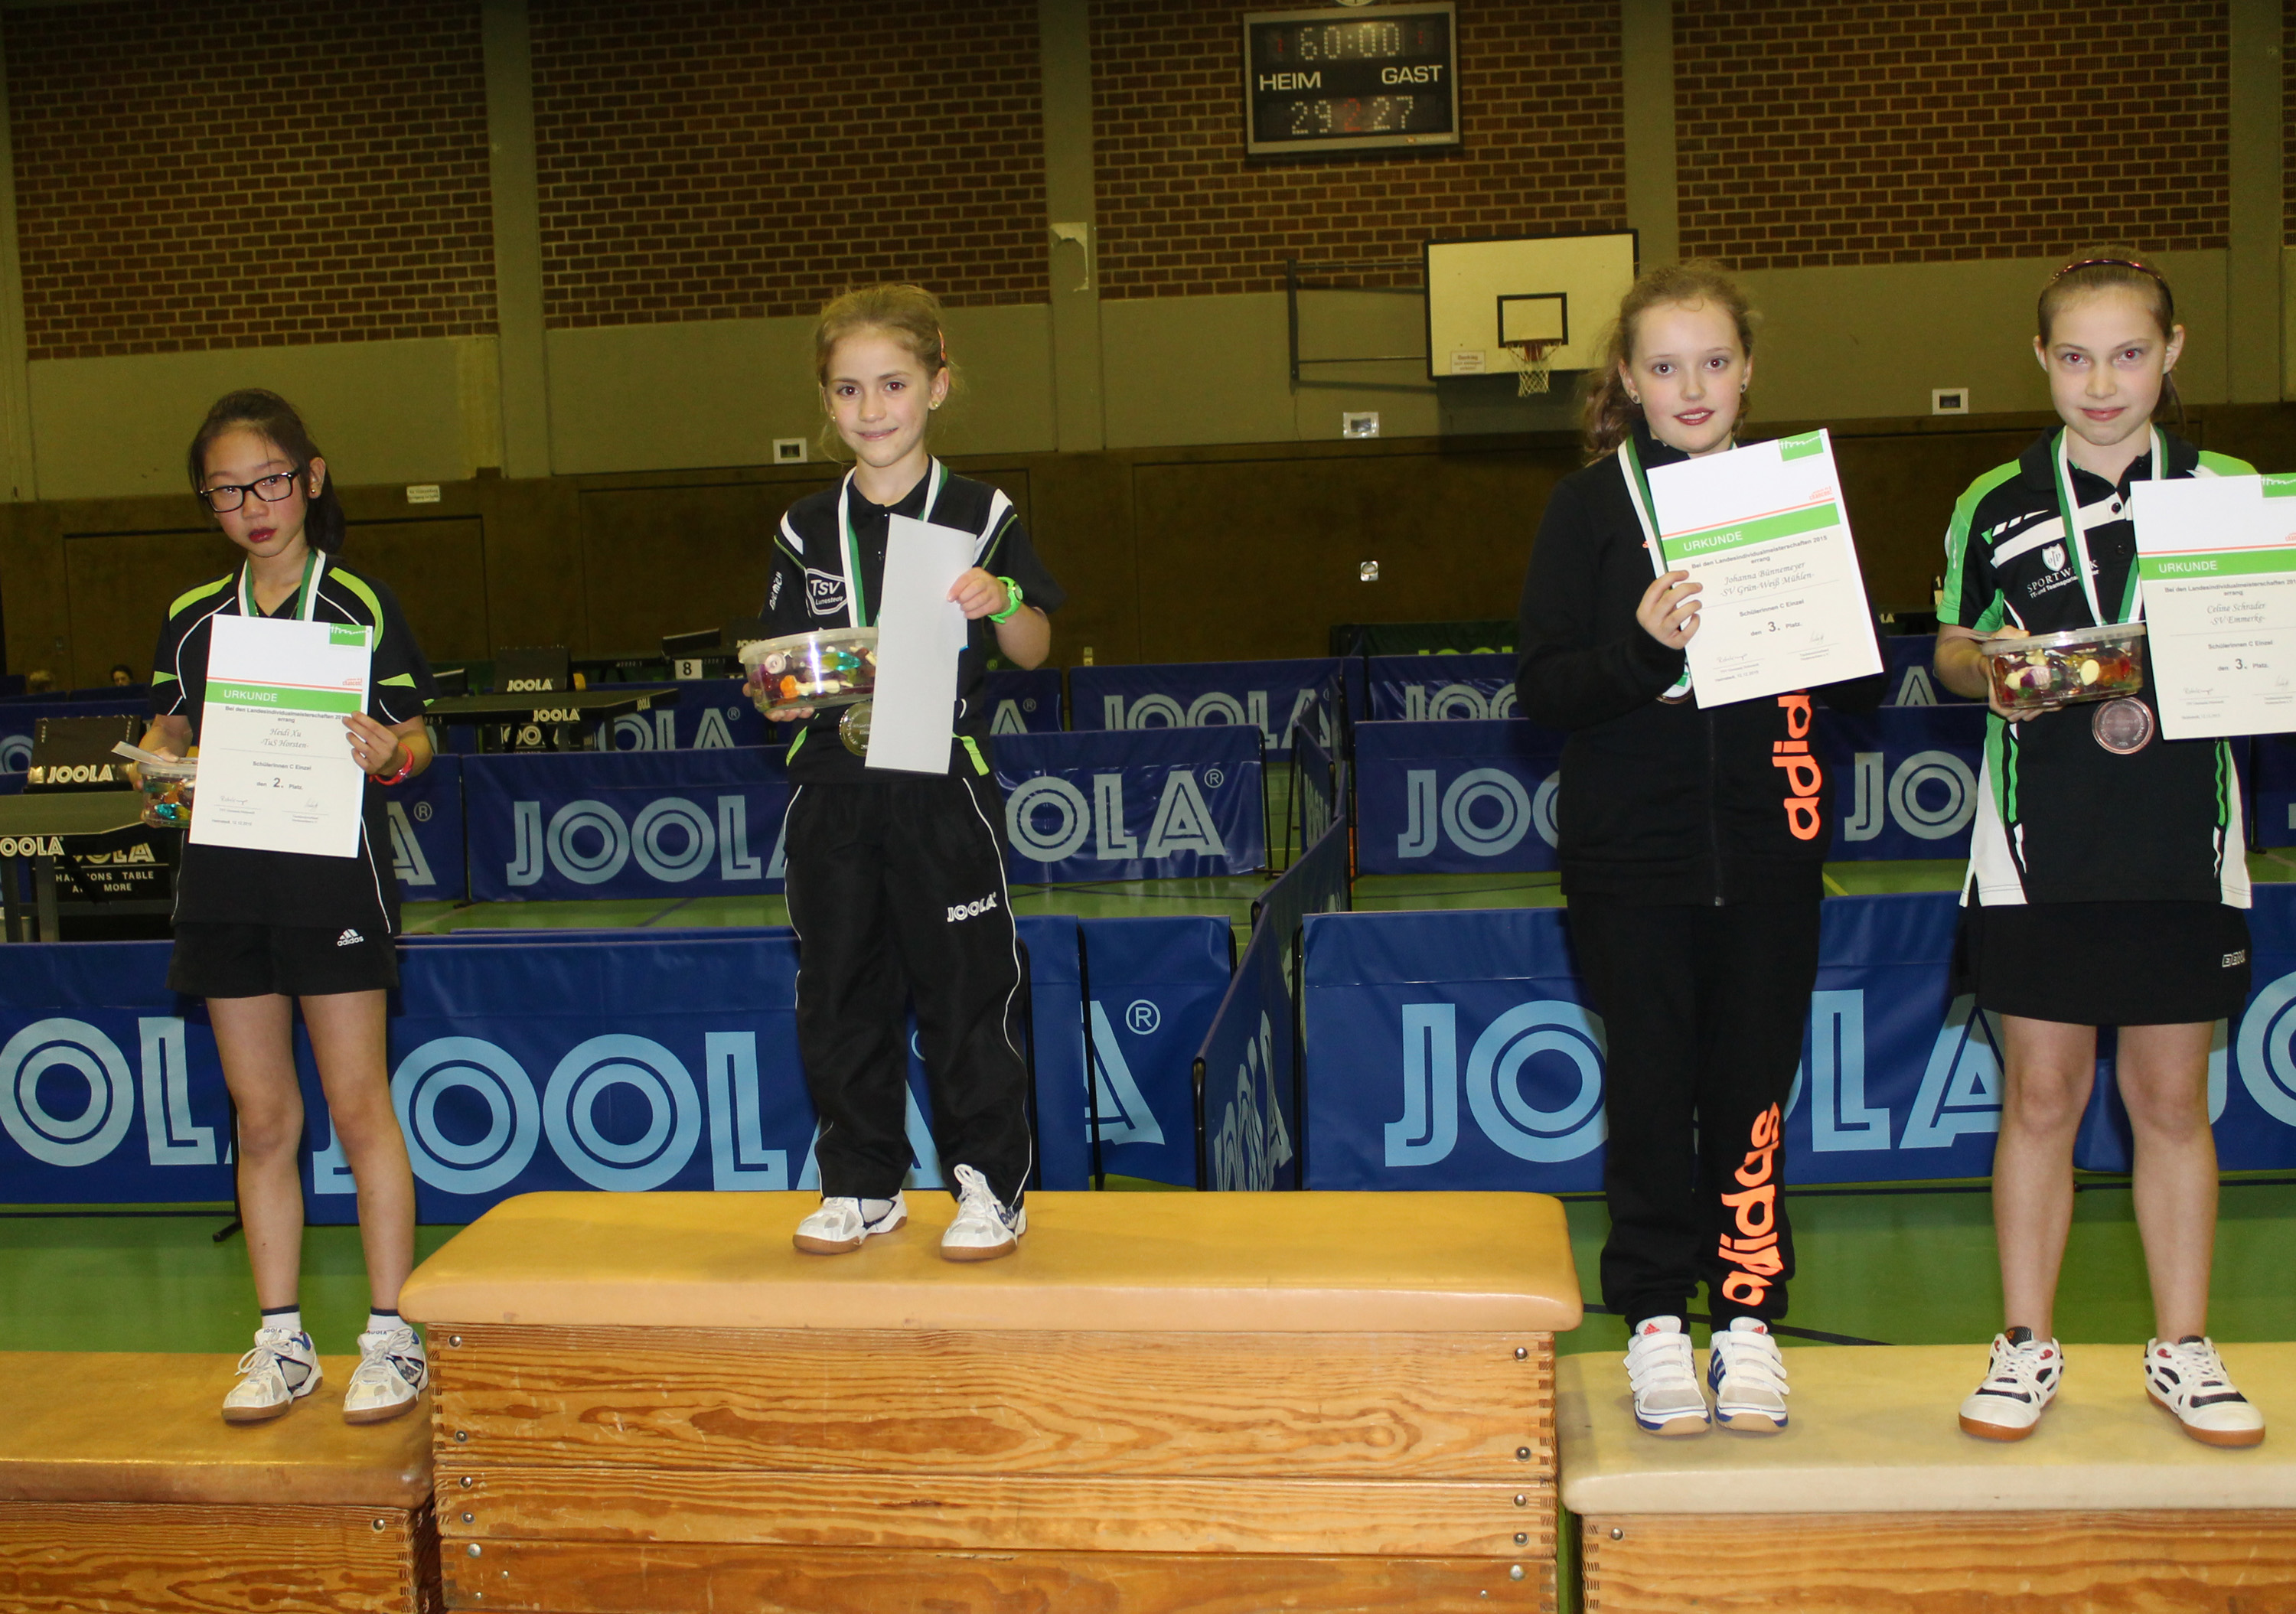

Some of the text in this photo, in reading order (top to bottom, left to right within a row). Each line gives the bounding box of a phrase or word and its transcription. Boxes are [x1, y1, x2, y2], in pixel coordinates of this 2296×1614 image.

[1301, 22, 1400, 60] 60:00
[1259, 65, 1443, 91] HEIM GAST
[1291, 96, 1414, 135] 29 2 27
[1683, 531, 1743, 551] URKUNDE
[1715, 539, 1812, 564] Landesindividualmeisterschaften
[1813, 535, 1828, 543] 2015
[1751, 556, 1771, 565] errang
[2158, 560, 2217, 573] URKUNDE
[1724, 562, 1805, 585] Johanna Bünnemeyer
[2027, 559, 2099, 593] SPORTWK
[810, 579, 840, 596] TSV
[2188, 579, 2285, 592] Landesindividualmeisterschaften
[1739, 605, 1779, 617] Schülerinnen
[2206, 601, 2265, 614] Celine Schrader
[1767, 621, 1781, 632] 3.
[683, 662, 692, 676] 8
[2235, 658, 2247, 670] 3.
[507, 679, 553, 692] JOOLA
[223, 690, 278, 702] URKUNDE
[247, 708, 334, 719] Landesindividualmeisterschaften
[533, 708, 580, 722] JOOLA
[253, 761, 288, 769] Schülerinnen
[1772, 693, 1822, 840] adid
[47, 765, 113, 784] JOOLA
[273, 778, 284, 788] 2.
[1005, 771, 1225, 862] OLA
[0, 836, 65, 857] OOLA
[506, 795, 786, 885] JOOL
[122, 871, 154, 880] TABLE
[103, 883, 132, 892] MORE
[947, 894, 997, 922] JOOLA
[337, 936, 364, 947] adidas
[1384, 990, 2004, 1167] JOLA
[1718, 1101, 1784, 1306] adidas
